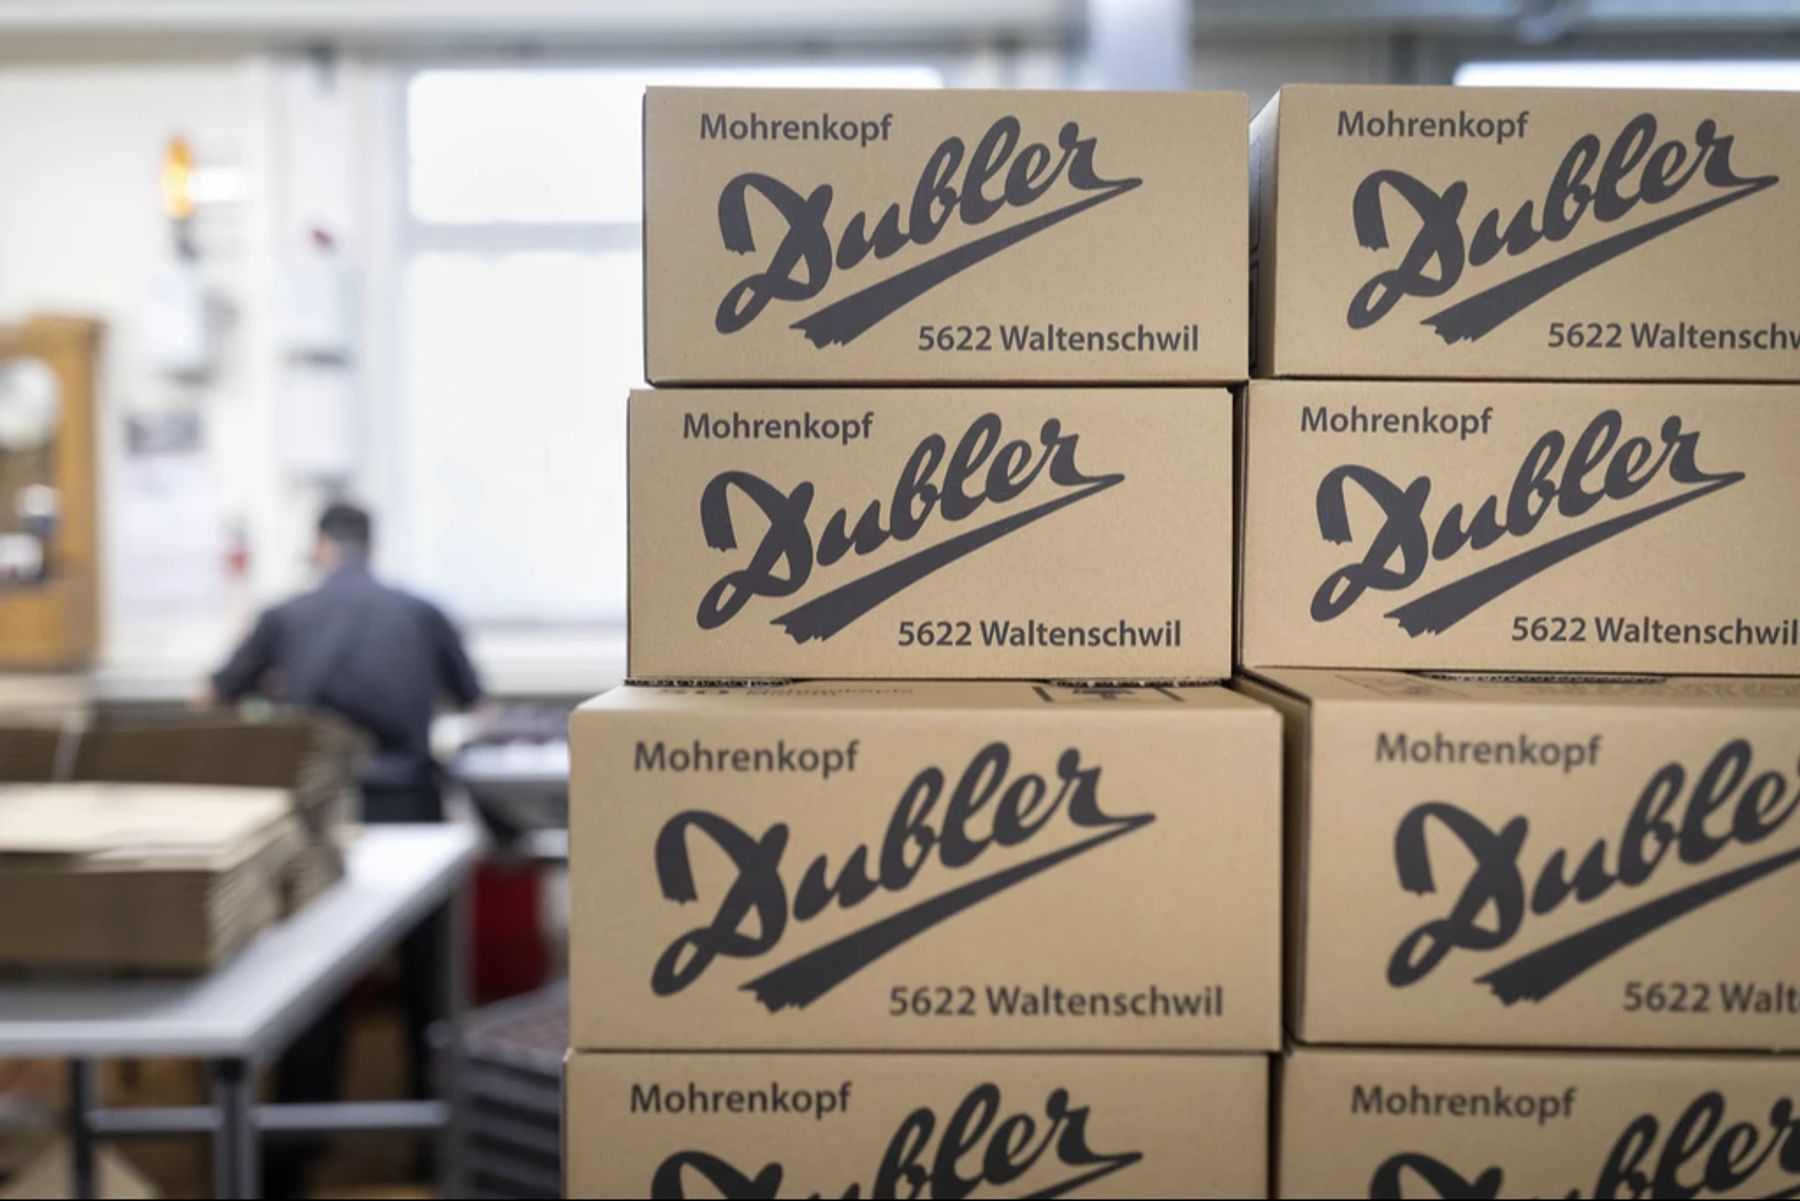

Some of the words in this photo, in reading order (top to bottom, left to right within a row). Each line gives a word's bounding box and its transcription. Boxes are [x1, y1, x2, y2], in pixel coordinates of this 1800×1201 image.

[700, 112, 893, 148] Mohrenkopf
[1337, 109, 1530, 145] Mohrenkopf
[714, 115, 1144, 336] Dubler
[1346, 112, 1780, 331] Dubler
[917, 325, 993, 352] 5622
[999, 323, 1199, 352] Waltenschwil
[1548, 322, 1622, 349] 5622
[683, 411, 875, 446] Mohrenkopf
[1300, 405, 1494, 441] Mohrenkopf
[696, 412, 1126, 631] Dubler
[1309, 408, 1747, 623] Dubler
[898, 620, 972, 647] 5622
[979, 619, 1181, 647] Waltenschwil
[1511, 616, 1586, 642] 5622
[1594, 616, 1799, 646] Waltenschwil
[634, 739, 859, 779] Mohrenkopf
[1375, 732, 1603, 775] Mohrenkopf
[650, 741, 1156, 998] Dubler
[1386, 738, 1800, 990] Duble
[889, 986, 976, 1017] 5622
[985, 984, 1223, 1017] Waltenschwil
[1625, 982, 1710, 1013] 5622
[1719, 982, 1800, 1014] Walt
[630, 1081, 852, 1121] Mohrenkopf
[1351, 1084, 1576, 1126] Mohrenkopf
[649, 1082, 1144, 1199] bler
